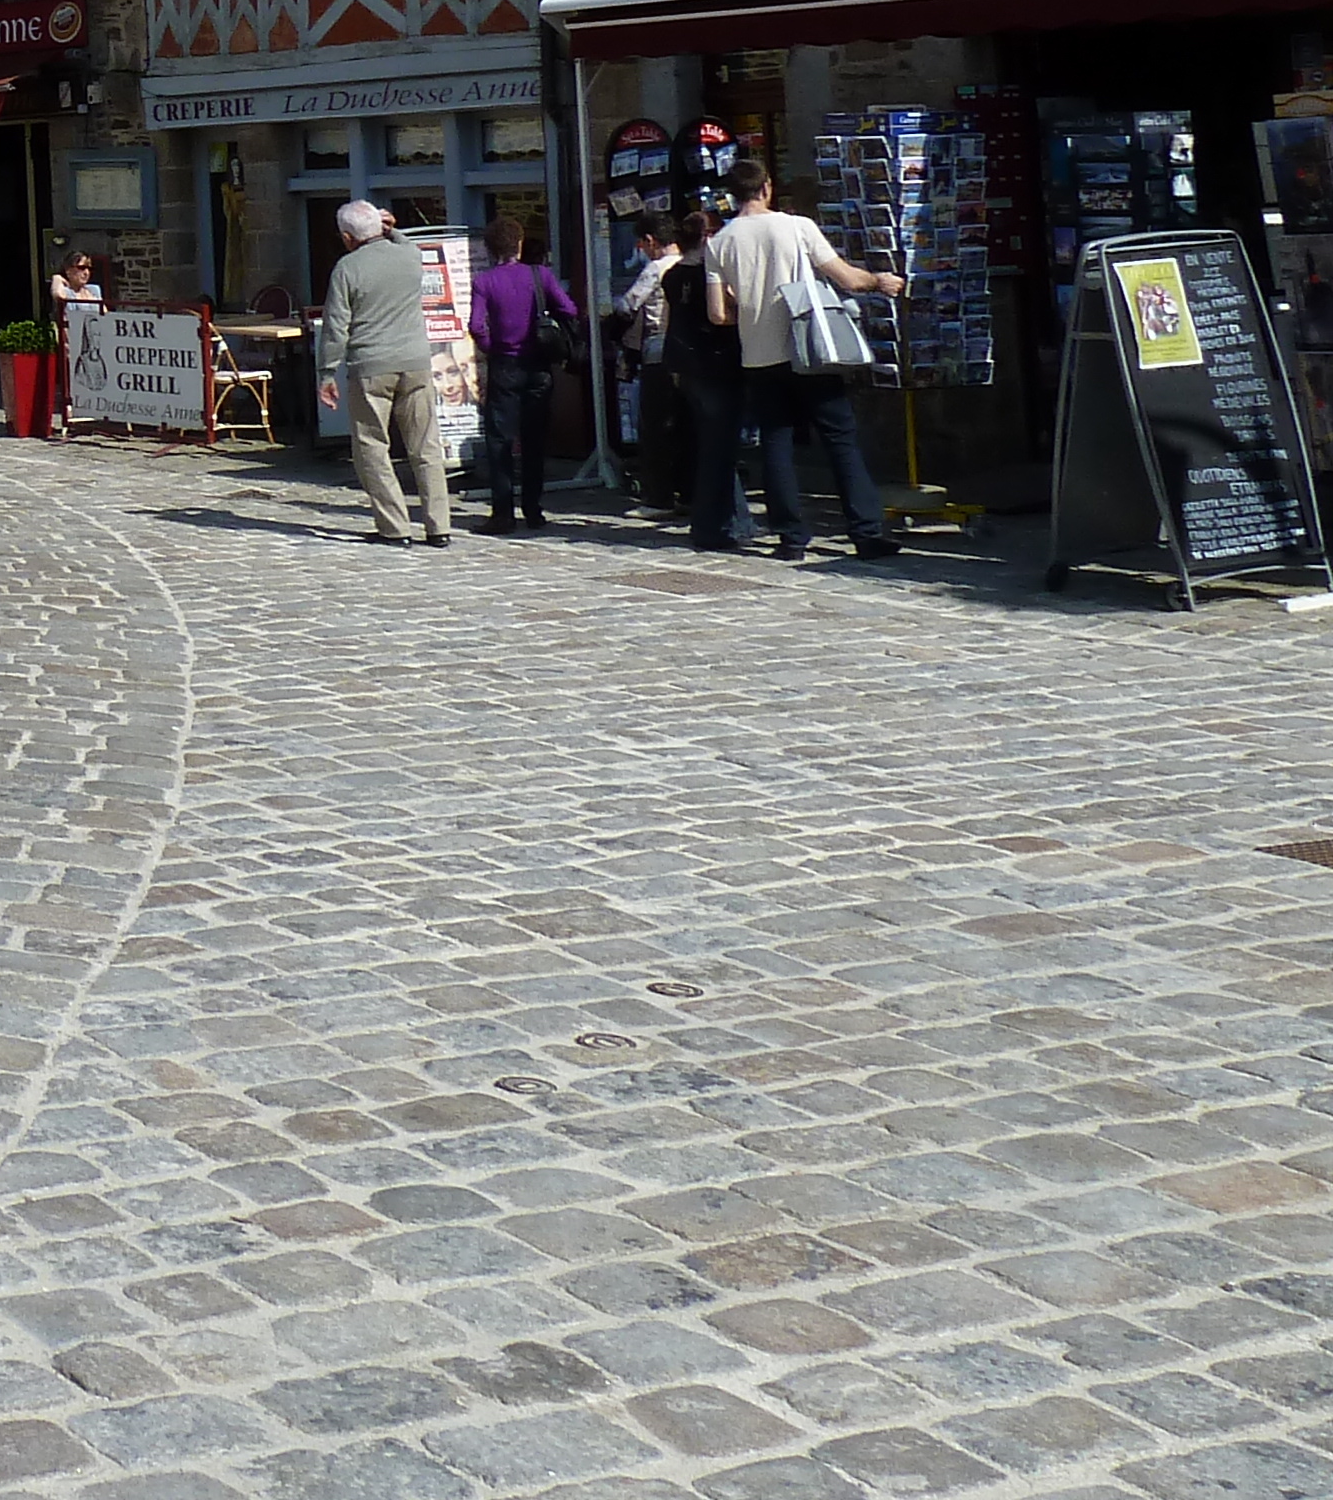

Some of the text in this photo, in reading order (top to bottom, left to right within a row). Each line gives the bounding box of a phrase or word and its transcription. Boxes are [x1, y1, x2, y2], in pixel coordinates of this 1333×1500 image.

[153, 78, 541, 123] CREPERIE La Duchesse Anne
[1185, 250, 1235, 266] EN VENTE
[115, 319, 157, 339] BAR
[115, 345, 198, 369] CREPERIE
[117, 372, 181, 395] GRILL
[74, 393, 202, 421] La Duchesse Anne
